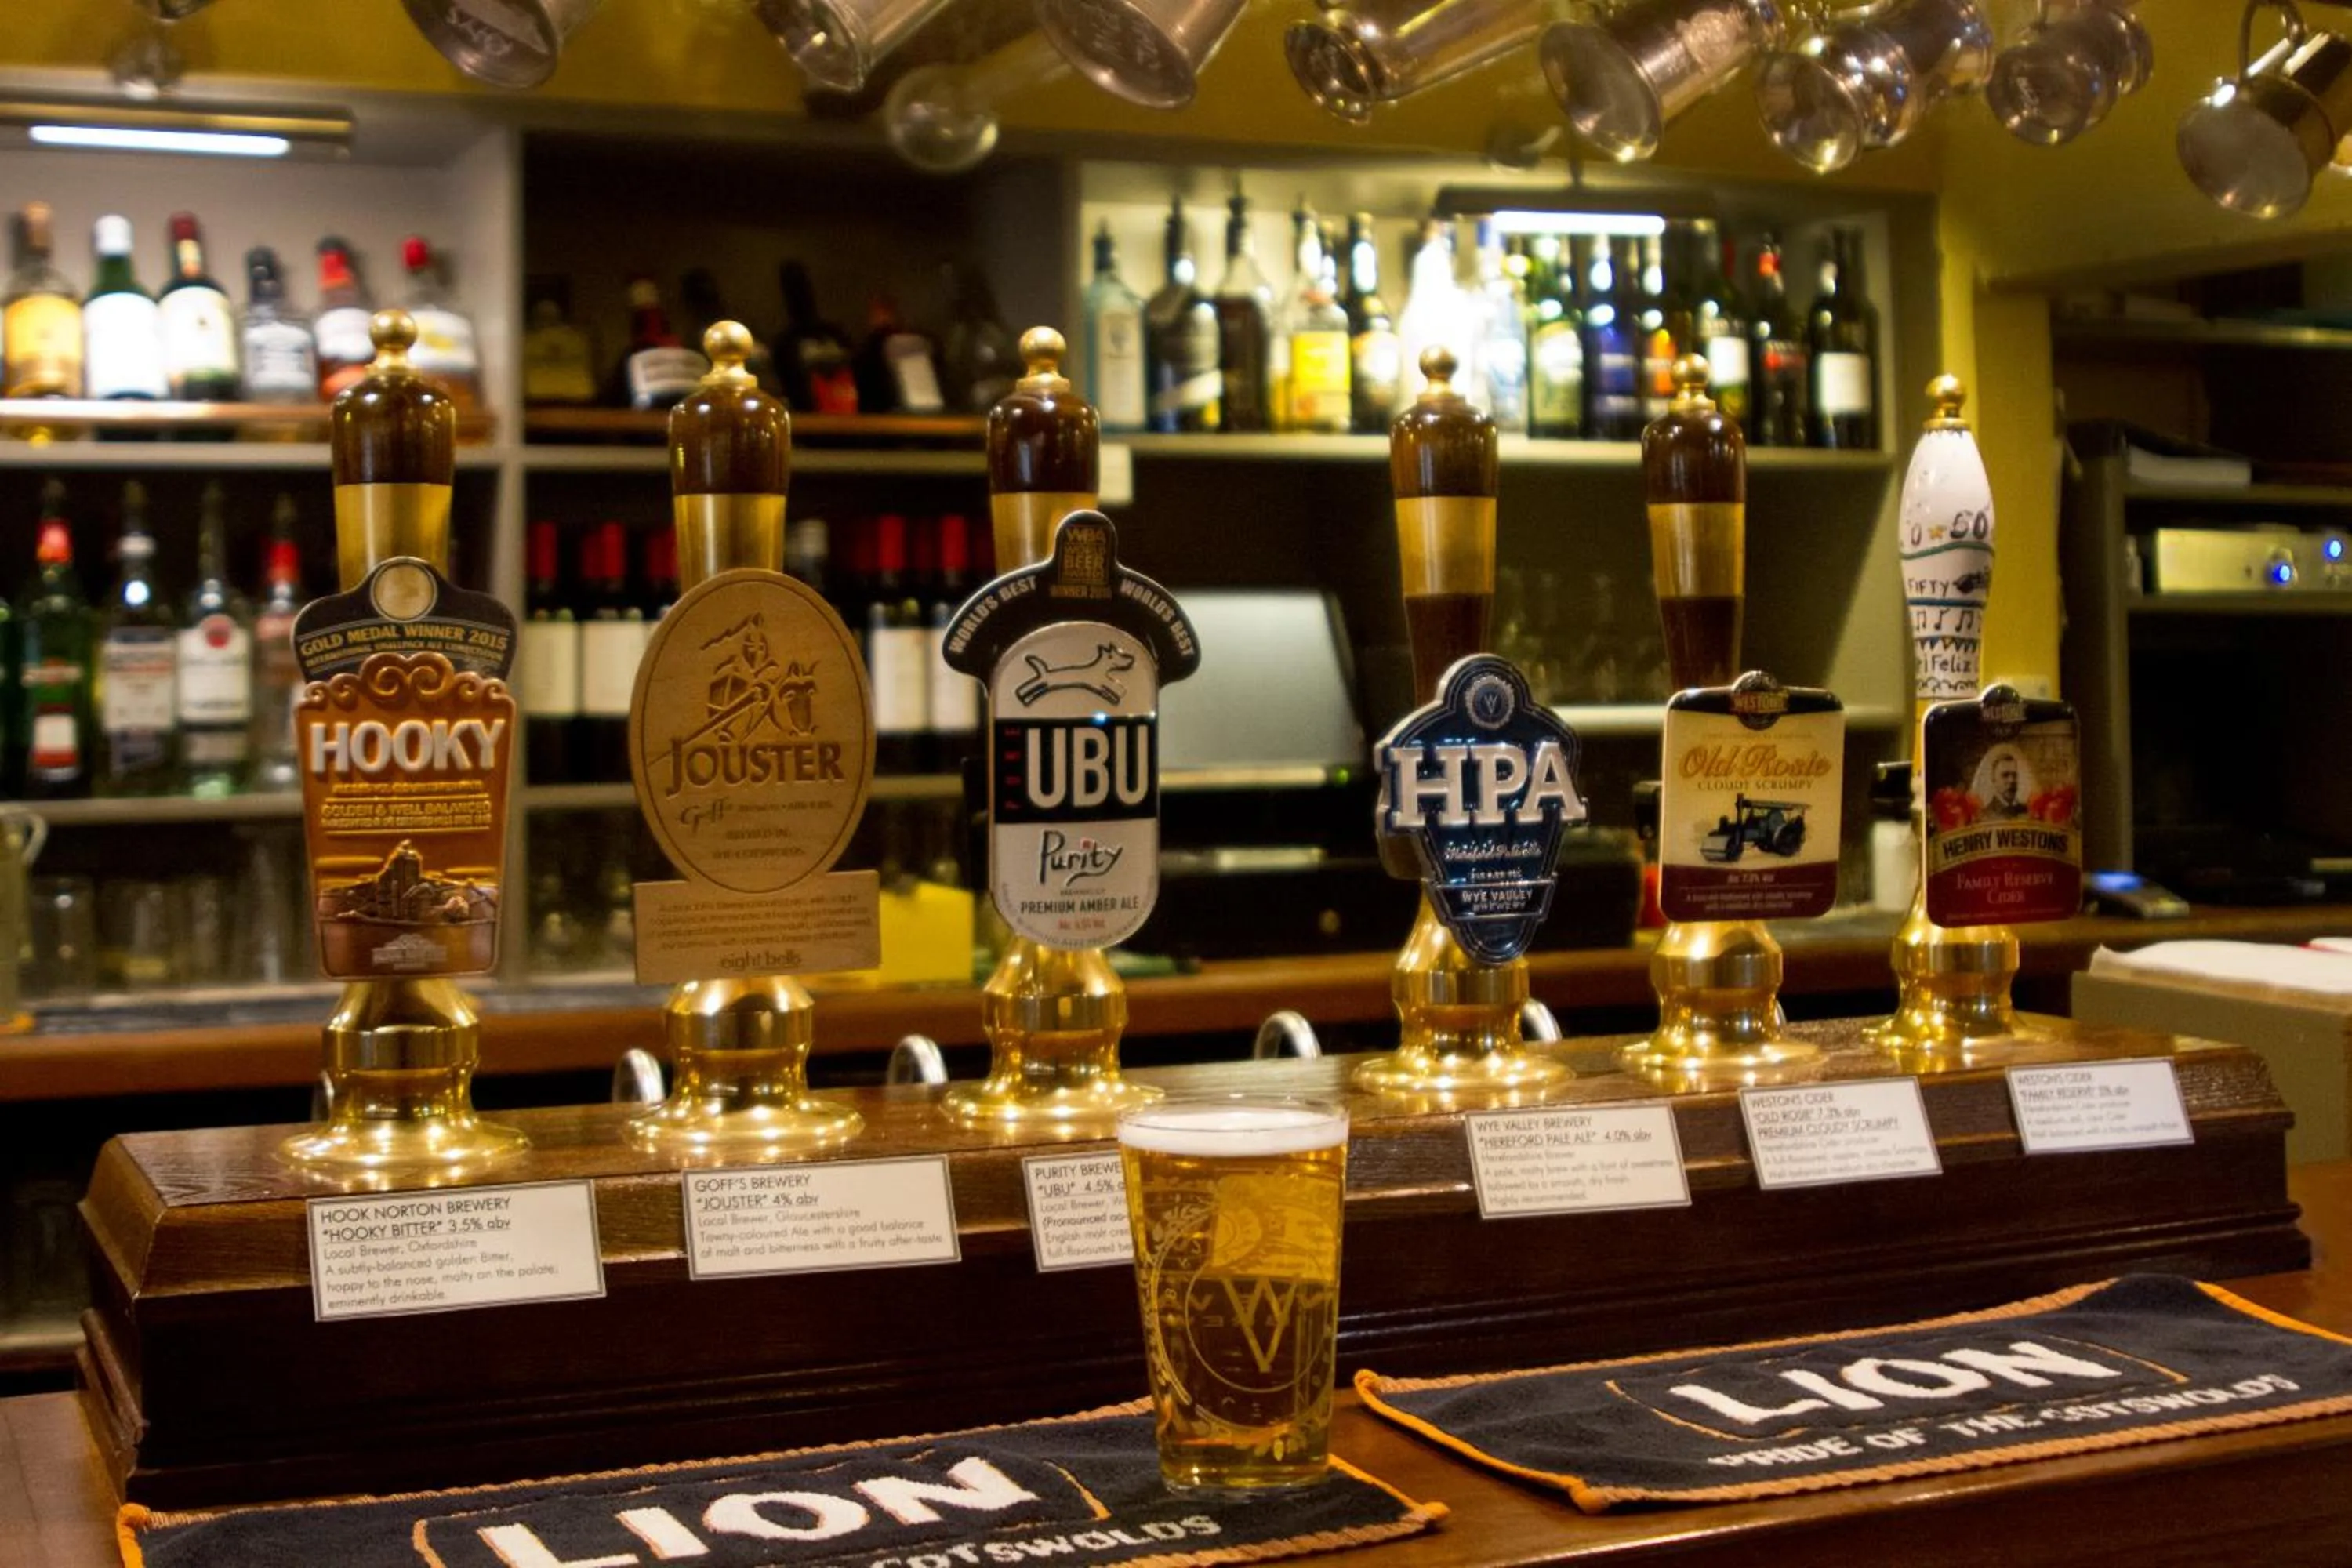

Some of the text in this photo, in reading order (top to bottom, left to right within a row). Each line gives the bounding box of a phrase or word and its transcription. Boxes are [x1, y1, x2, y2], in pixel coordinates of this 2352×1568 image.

[1908, 579, 1950, 597] FIFTY
[949, 575, 1036, 654] WORLD'S BEST
[1119, 579, 1195, 655] WORLD'S BEST
[301, 623, 508, 657] GOLD MEDAL WINNER 2015
[310, 718, 506, 774] HOOKY
[665, 736, 845, 800] JOUSTER
[1027, 724, 1149, 808] UBU
[1679, 743, 1832, 779] Old Rosie
[1389, 740, 1587, 829] HPA
[425, 800, 492, 813] BALANCED
[1943, 829, 2069, 860] HENRY WESTONS
[1038, 829, 1123, 887] Purity
[1957, 872, 2053, 890] FAMILY RESERVE
[1021, 895, 1139, 915] PREMIUM AMBER ALE
[1461, 889, 1534, 902] WYE VALLEY
[1987, 891, 2025, 904] CIDER
[720, 952, 761, 971] eight
[1475, 1116, 1592, 1132] WYE VALLEY BREWERY
[1546, 1132, 1570, 1145] PALE
[1035, 1161, 1122, 1180] PURITY BREWE
[695, 1174, 811, 1193] GOFF'S BREWERY
[771, 1192, 792, 1205] 4%
[797, 1192, 820, 1206] abv
[1040, 1197, 1066, 1212] Local
[321, 1197, 511, 1225] HOOK NORTON BREWERY
[698, 1215, 727, 1228] Local
[776, 1207, 861, 1223] Gloucestershire
[1043, 1213, 1106, 1230] (Pronounced
[448, 1217, 485, 1232] 3.5%
[487, 1217, 511, 1230] abv
[700, 1227, 788, 1244] Tawny-coloured
[791, 1225, 809, 1237] Ale
[812, 1223, 834, 1235] with
[848, 1221, 877, 1236] good
[880, 1218, 924, 1232] balance
[323, 1237, 477, 1260] Local Brewer, Oxfordshire
[700, 1247, 712, 1259] of
[716, 1244, 741, 1257] malt
[744, 1243, 765, 1256] and
[769, 1240, 820, 1254] bitterness
[823, 1238, 845, 1250] with
[859, 1236, 885, 1250] fruity
[325, 1265, 335, 1276] A
[338, 1258, 432, 1276] subtly-balanced
[436, 1254, 475, 1269] golden
[327, 1279, 364, 1295] hoppy
[368, 1279, 379, 1290] to
[383, 1275, 402, 1288] the
[442, 1269, 473, 1284] malty
[477, 1269, 492, 1279] on
[496, 1265, 514, 1279] the
[328, 1294, 386, 1310] eminently
[1669, 1341, 2122, 1425] LION
[1708, 1374, 2300, 1466] PRIDE OF THE COTSWOLDS
[475, 1456, 1040, 1568] LION
